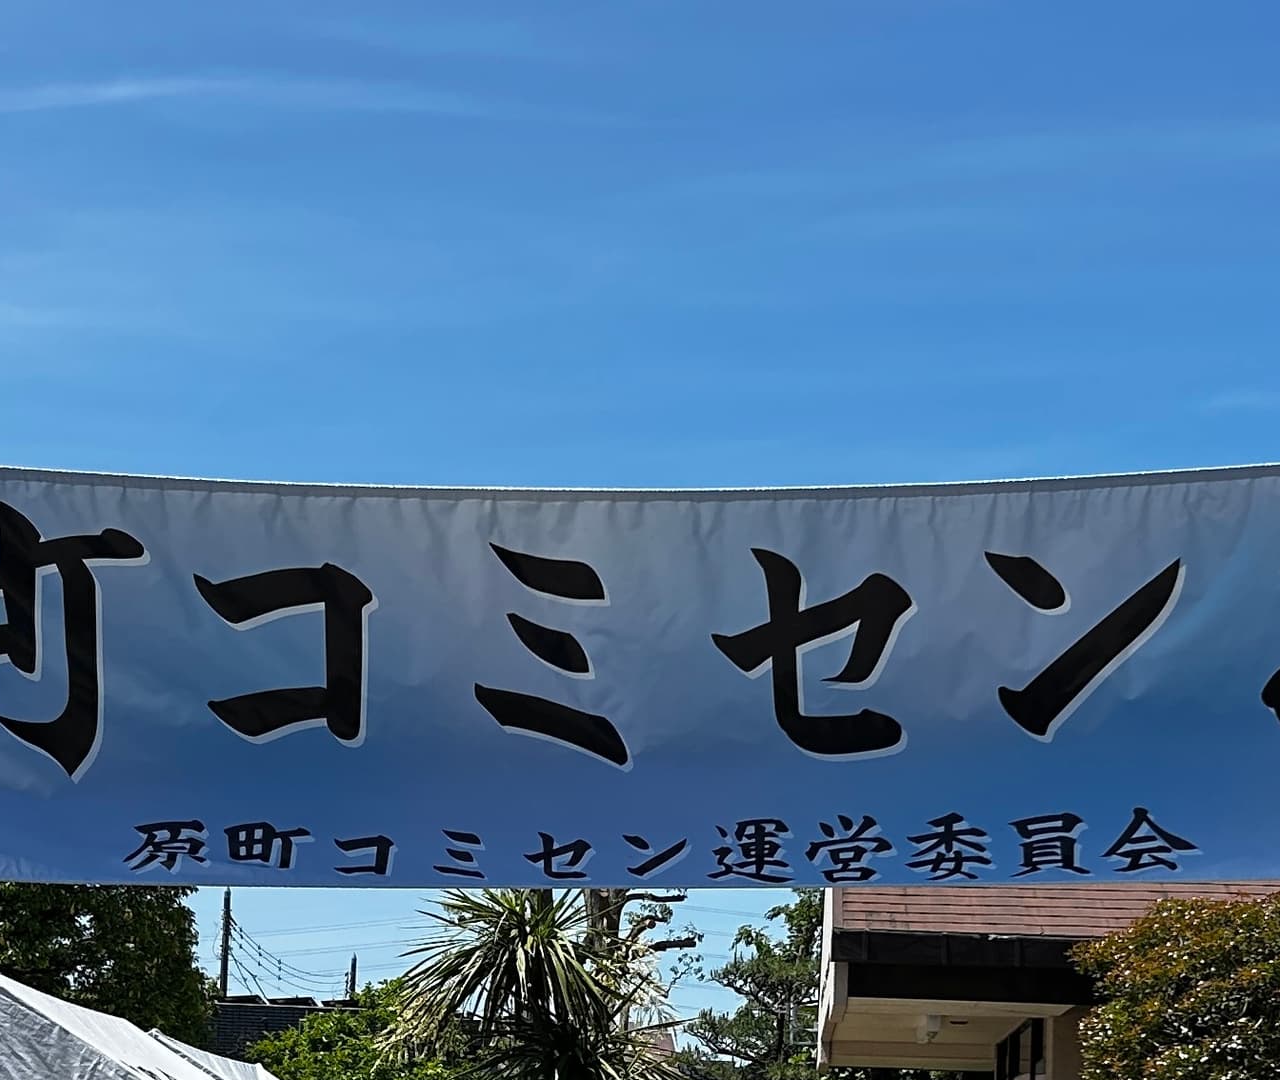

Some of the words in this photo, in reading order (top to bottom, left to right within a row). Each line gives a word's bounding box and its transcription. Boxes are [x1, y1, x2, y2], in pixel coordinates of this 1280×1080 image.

[122, 806, 1202, 883] 原町コミセン運営委員会
